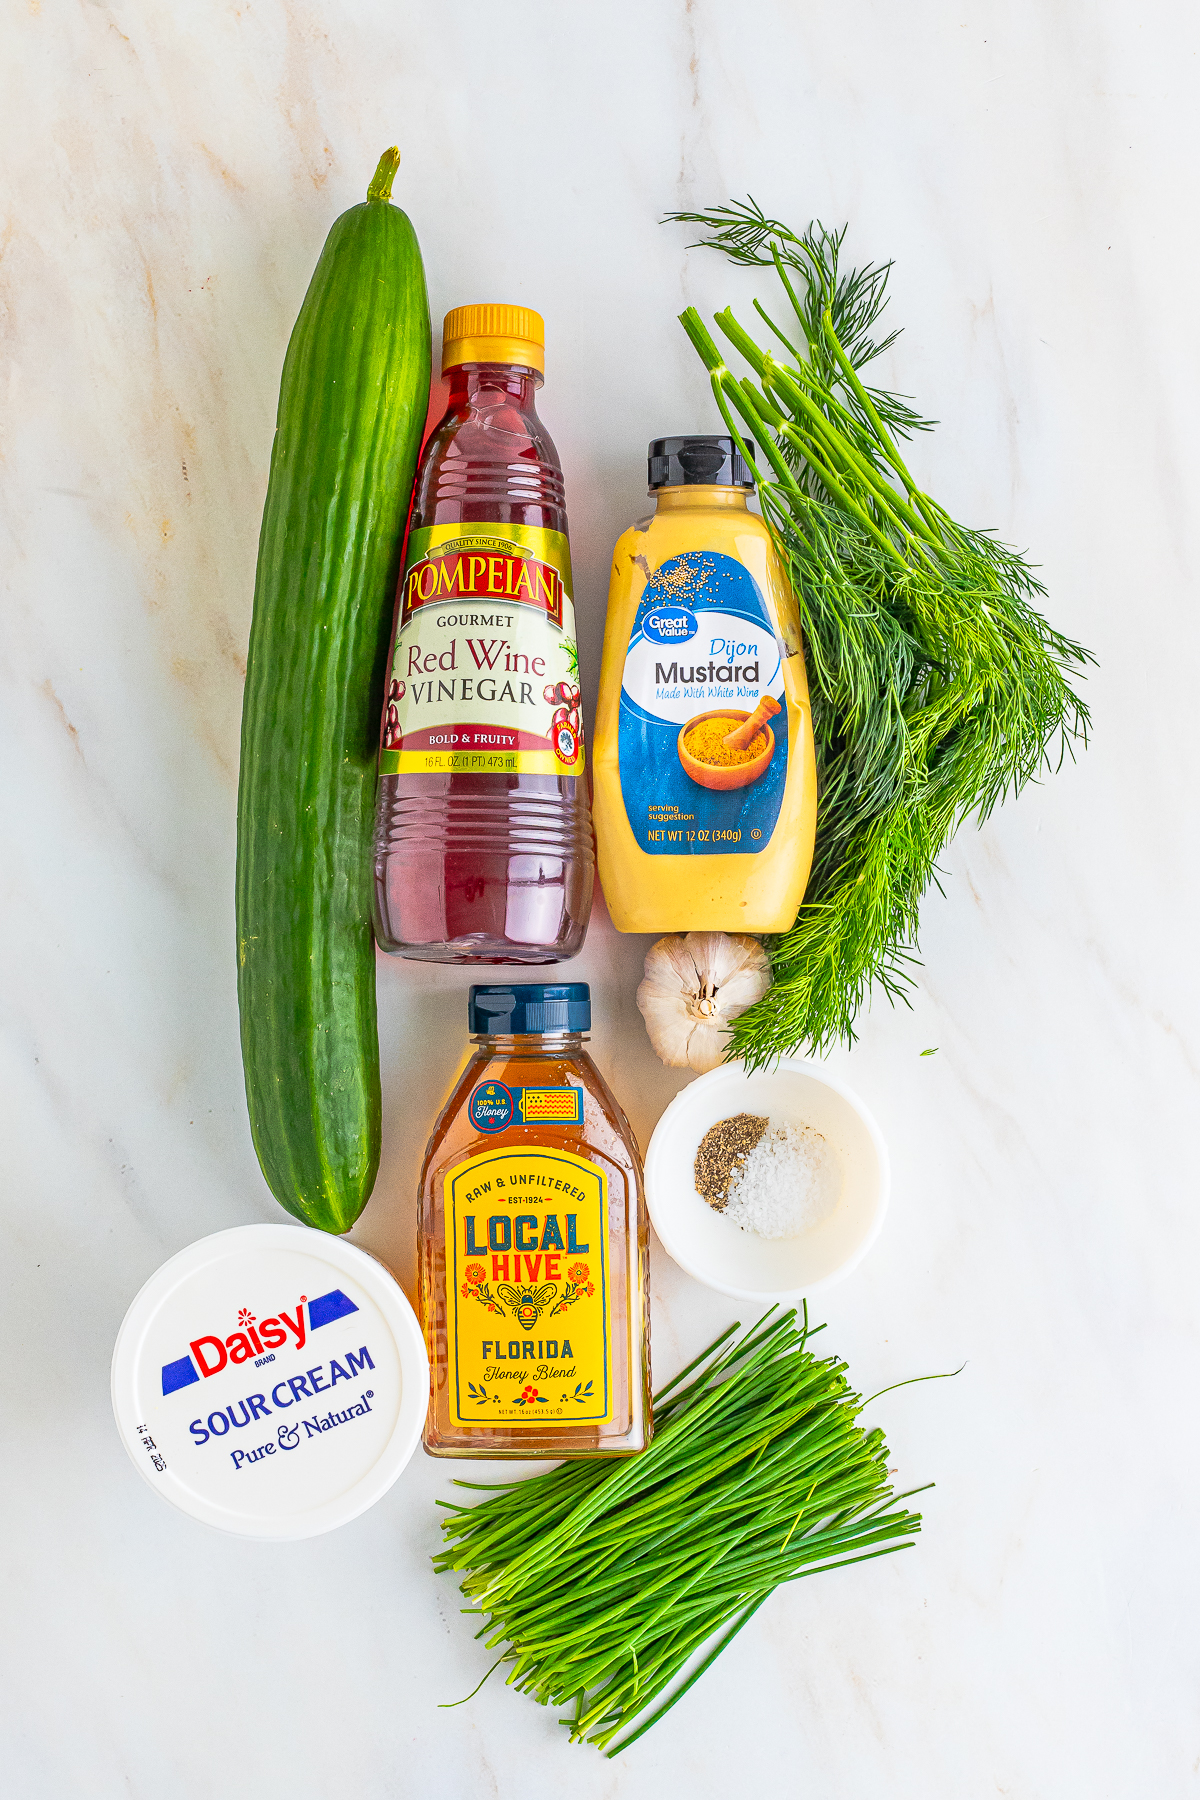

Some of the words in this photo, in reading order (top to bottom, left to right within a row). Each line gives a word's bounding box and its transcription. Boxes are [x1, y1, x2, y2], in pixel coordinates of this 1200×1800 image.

[445, 538, 474, 550] QUALITY
[475, 538, 496, 547] SINCE
[498, 541, 513, 551] 1906
[406, 556, 556, 610] POMPEIAN
[436, 614, 514, 628] GOURMET
[649, 615, 688, 629] Great
[406, 638, 458, 678] Red
[465, 638, 546, 677] Wine
[709, 638, 758, 664] Dijon
[655, 661, 760, 684] Mustard
[410, 678, 536, 706] VINEGAR
[655, 686, 681, 700] Made
[683, 685, 705, 699] With
[707, 685, 734, 698] White
[736, 685, 760, 698] Wine
[429, 734, 459, 745] BOLD
[461, 733, 471, 743] &
[473, 733, 516, 746] FRUITY
[425, 756, 433, 767] 16
[434, 756, 445, 767] FL.
[487, 756, 504, 768] 473
[505, 757, 518, 768] mL
[555, 748, 576, 764] OWNED
[648, 804, 679, 814] serving
[648, 812, 695, 822] suggestion
[648, 830, 666, 842] NET
[667, 830, 683, 842] WT
[685, 830, 696, 841] 12
[697, 829, 710, 842] OZ
[712, 828, 742, 843] (340g)
[495, 1098, 508, 1106] U.S.
[475, 1105, 509, 1120] Honey
[465, 1181, 492, 1204] RAW
[496, 1177, 506, 1188] &
[509, 1174, 586, 1202] UNFILTERED
[463, 1213, 590, 1256] LOCAL
[491, 1253, 562, 1283] HIVE
[189, 1303, 307, 1379] Daisy
[481, 1339, 574, 1360] FLORIDA
[254, 1353, 276, 1368] BRAND
[483, 1365, 529, 1385] Honey
[532, 1364, 577, 1381] Blend
[189, 1393, 273, 1446] SOUR
[271, 1345, 376, 1408] CREAM
[230, 1442, 277, 1471] Pure
[277, 1422, 300, 1451] &
